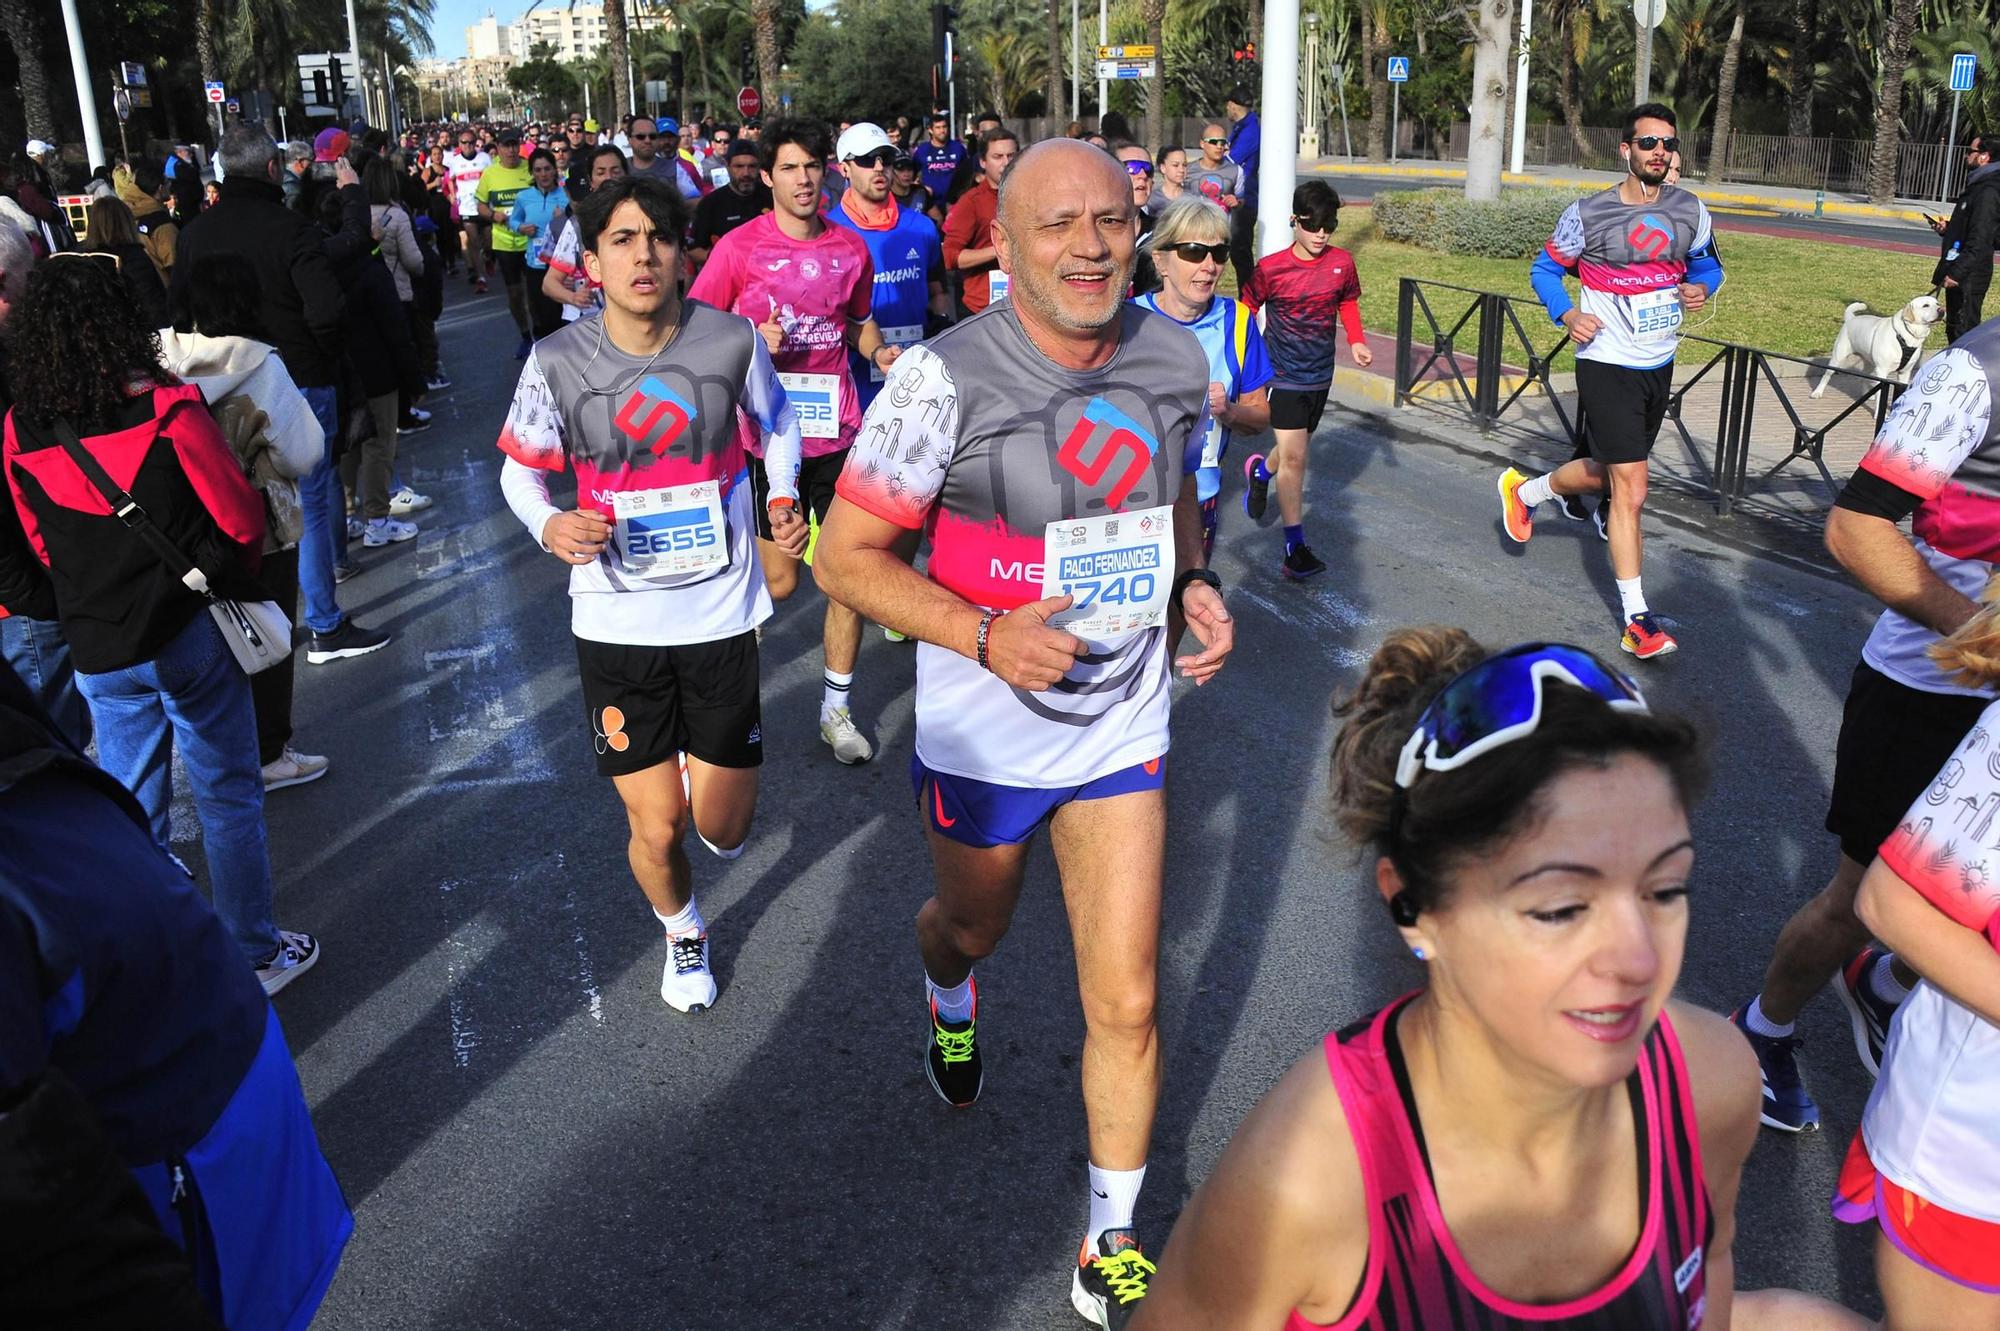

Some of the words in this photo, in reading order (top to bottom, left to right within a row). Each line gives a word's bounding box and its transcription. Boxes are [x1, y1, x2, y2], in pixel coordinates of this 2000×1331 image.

[740, 98, 759, 107] STOP
[1638, 315, 1680, 333] 2230
[791, 404, 832, 420] 532
[627, 525, 716, 556] 2655
[1063, 556, 1093, 579] PACO
[1094, 546, 1156, 576] FERNANDEZ
[1061, 573, 1155, 610] 1740
